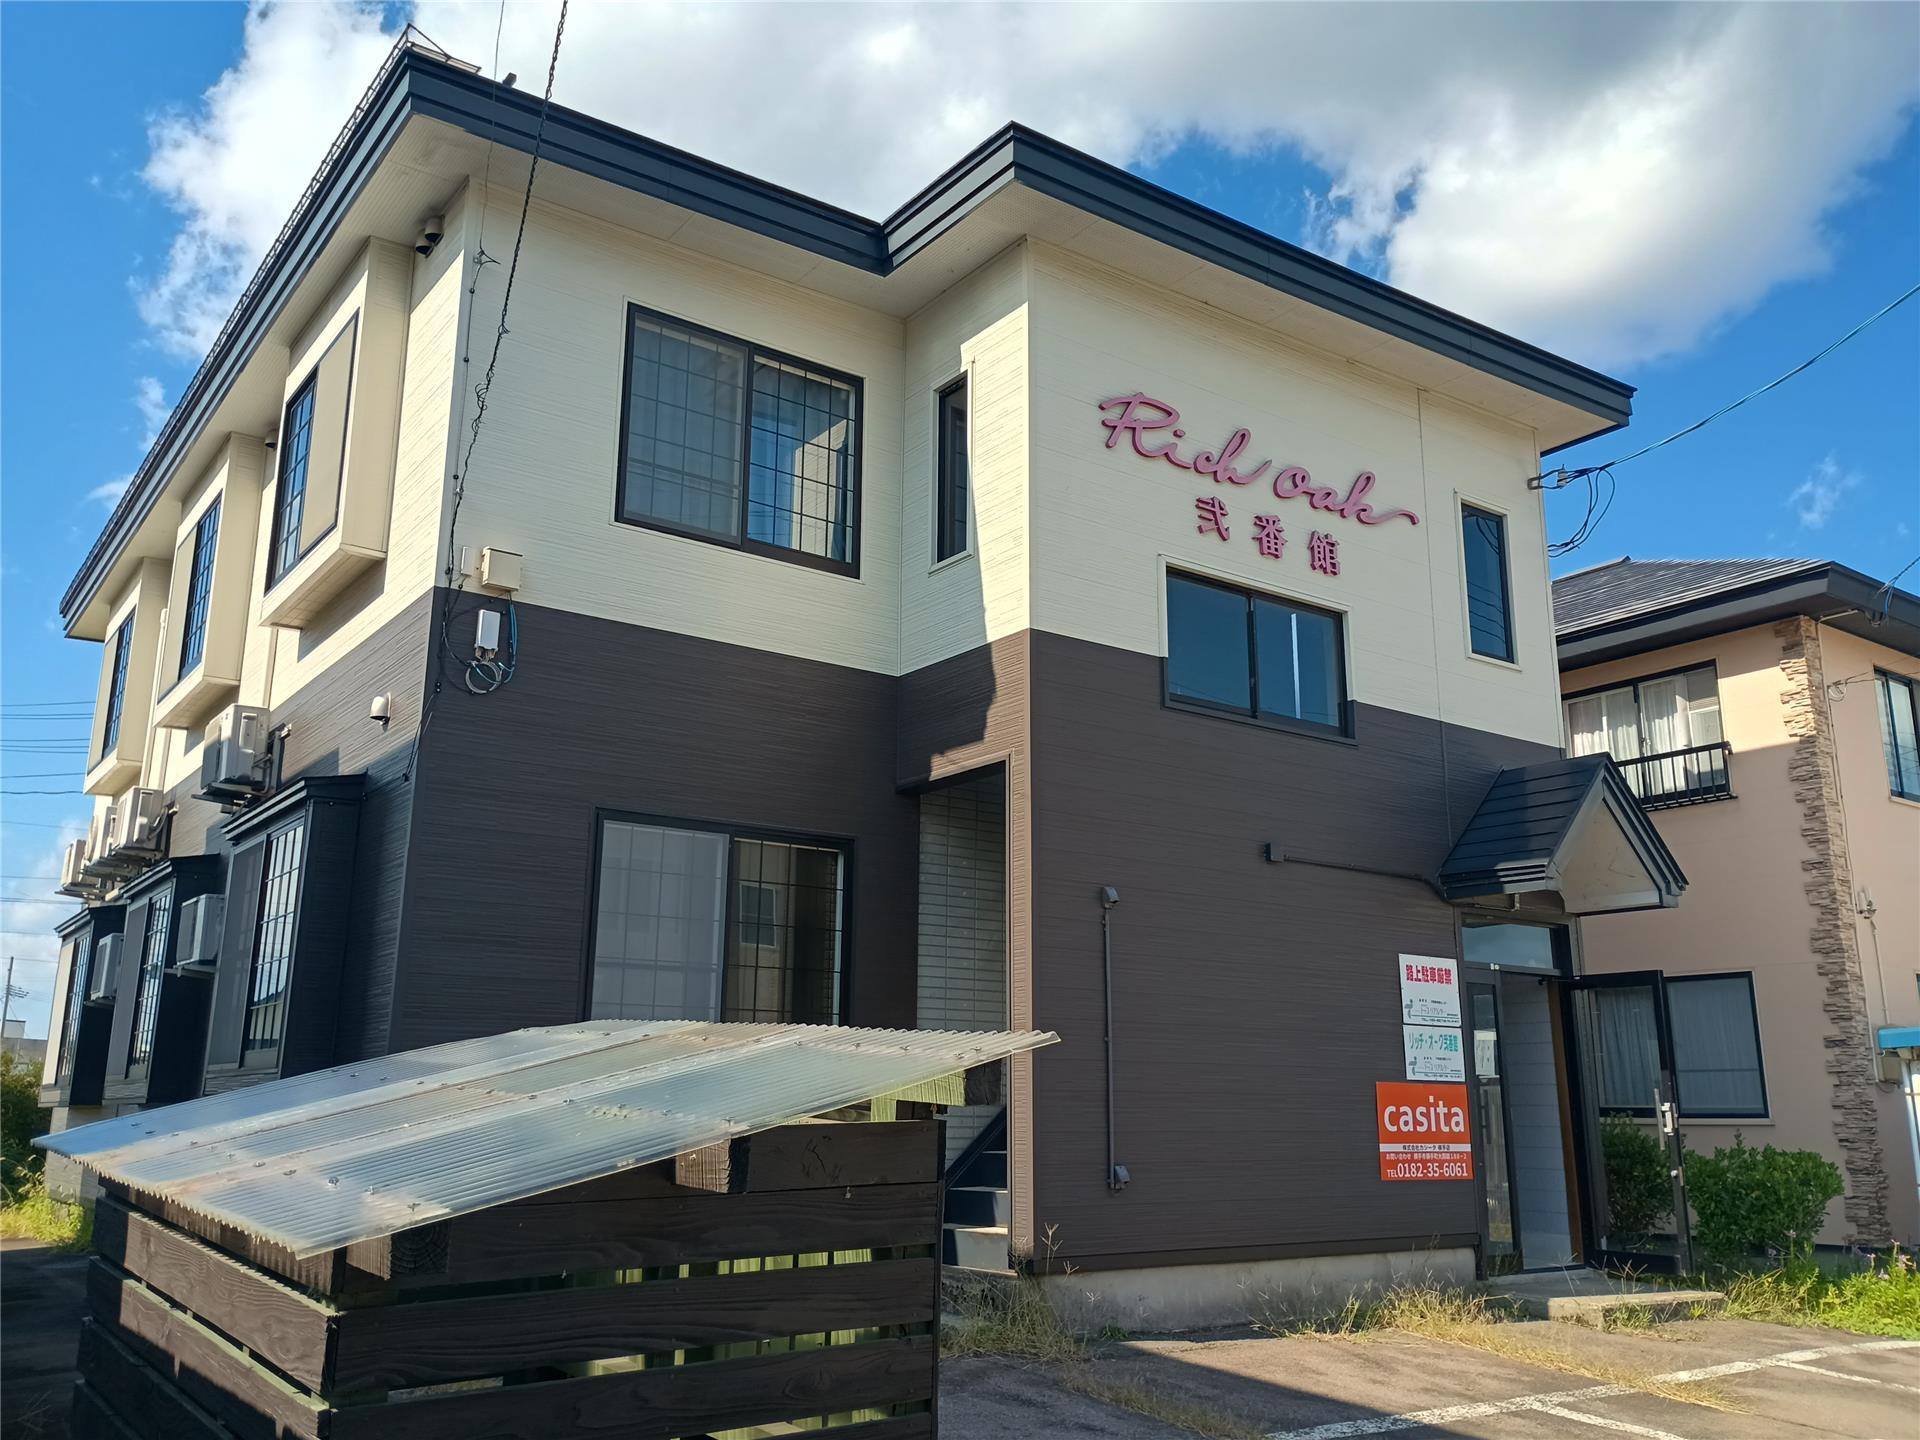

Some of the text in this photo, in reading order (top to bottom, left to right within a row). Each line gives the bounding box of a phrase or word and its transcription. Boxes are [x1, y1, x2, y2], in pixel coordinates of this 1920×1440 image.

[1098, 392, 1420, 526] Rich Oak
[1384, 1095, 1464, 1132] casita
